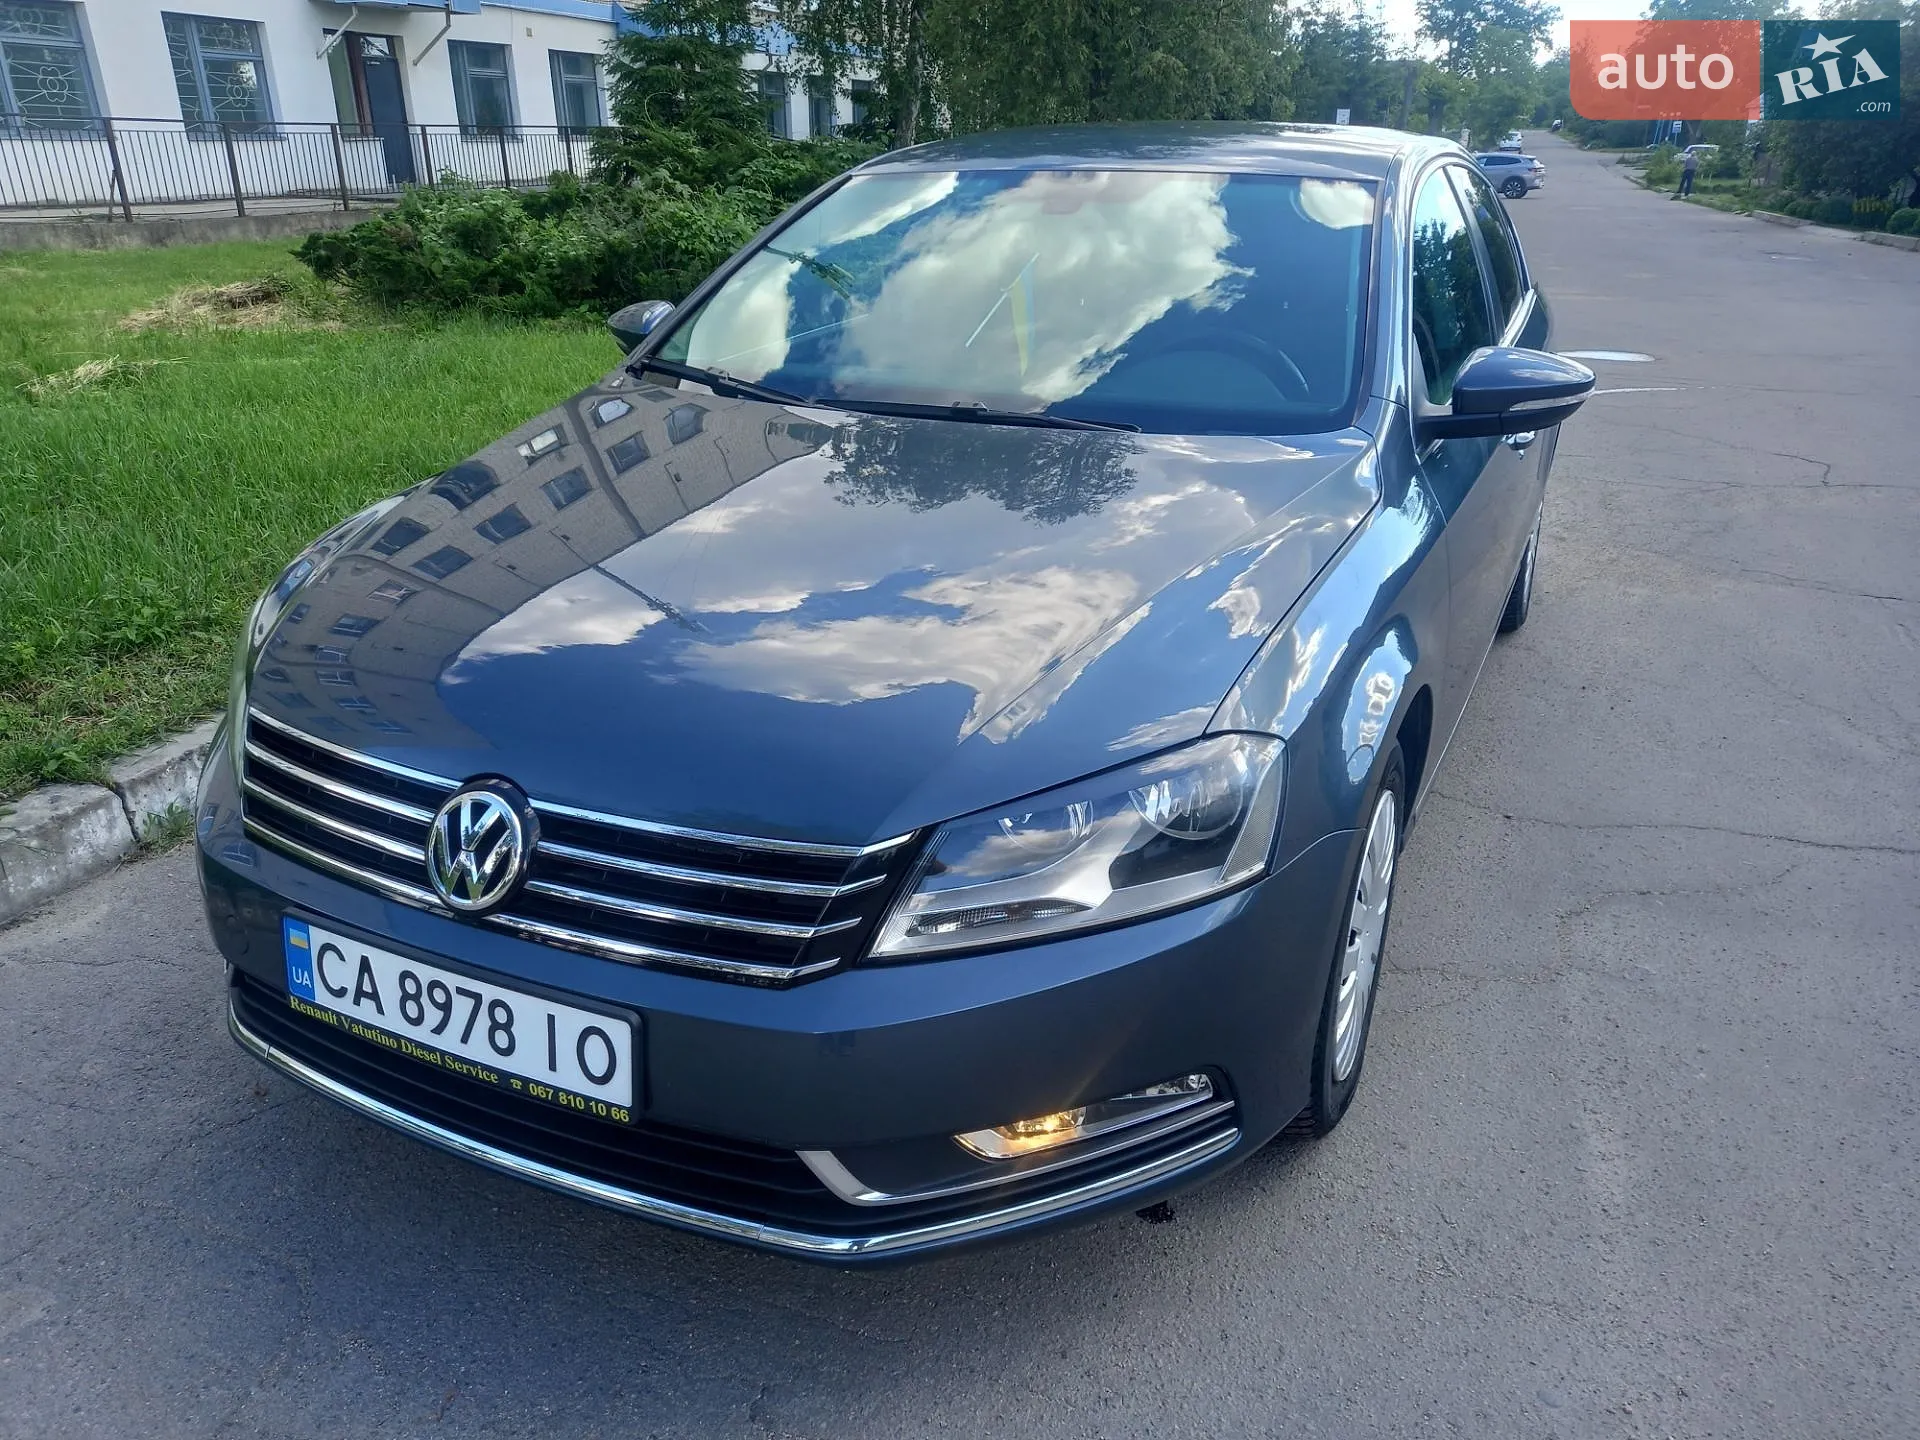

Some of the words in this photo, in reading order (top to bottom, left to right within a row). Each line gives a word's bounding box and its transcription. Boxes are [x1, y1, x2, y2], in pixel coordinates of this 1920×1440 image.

[292, 966, 312, 989] UA
[316, 942, 385, 1016] CA
[399, 970, 516, 1056] 8978
[547, 1013, 617, 1085] IO
[290, 995, 338, 1026] Renault
[340, 1015, 398, 1049] Vatutino
[401, 1039, 441, 1065] Diesel
[444, 1055, 500, 1084] Service
[529, 1083, 554, 1100] 067
[558, 1092, 585, 1110] 810
[589, 1101, 607, 1116] 10
[611, 1107, 630, 1122] 66
